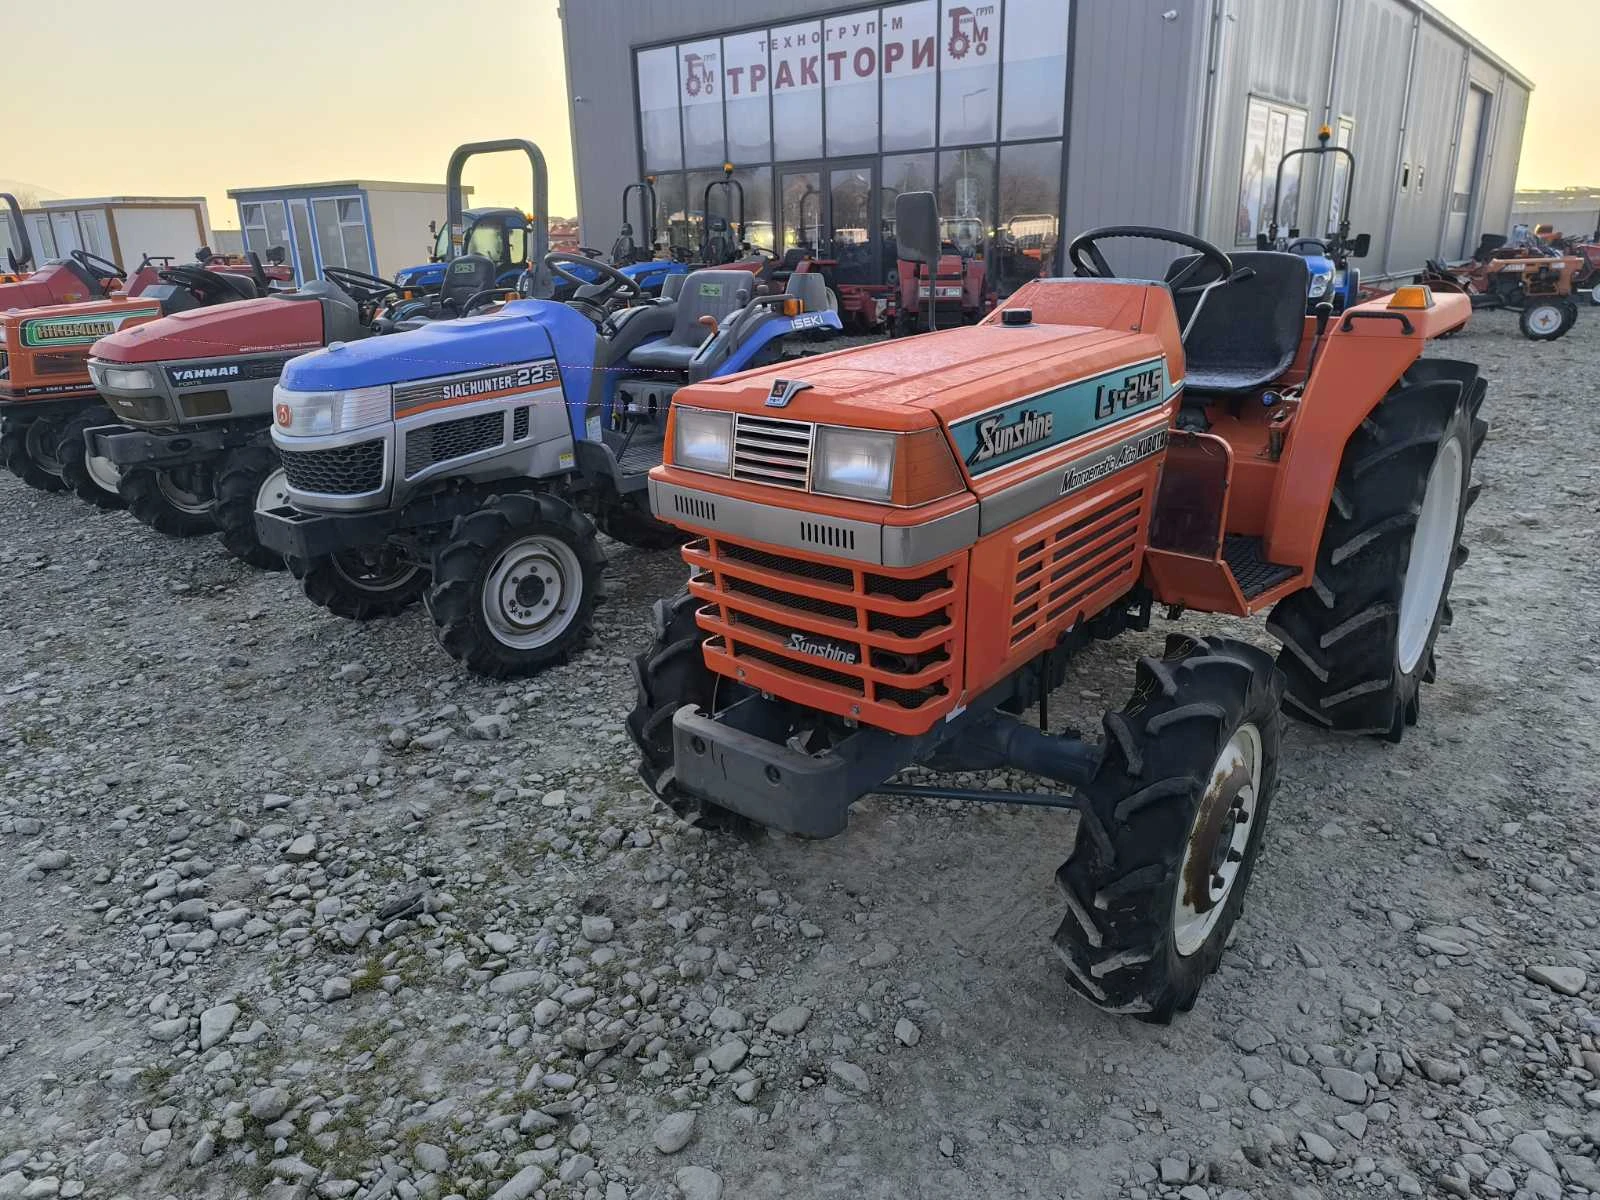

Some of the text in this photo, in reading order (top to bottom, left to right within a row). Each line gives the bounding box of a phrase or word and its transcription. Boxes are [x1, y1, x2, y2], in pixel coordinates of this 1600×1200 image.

[727, 36, 935, 95] ТРАКТОРИ
[791, 315, 824, 329] ISEKI
[173, 366, 239, 380] YANMAR
[968, 410, 1054, 466] Sunshine
[1136, 429, 1167, 460] KUBOTA
[784, 633, 856, 664] Sunshine
